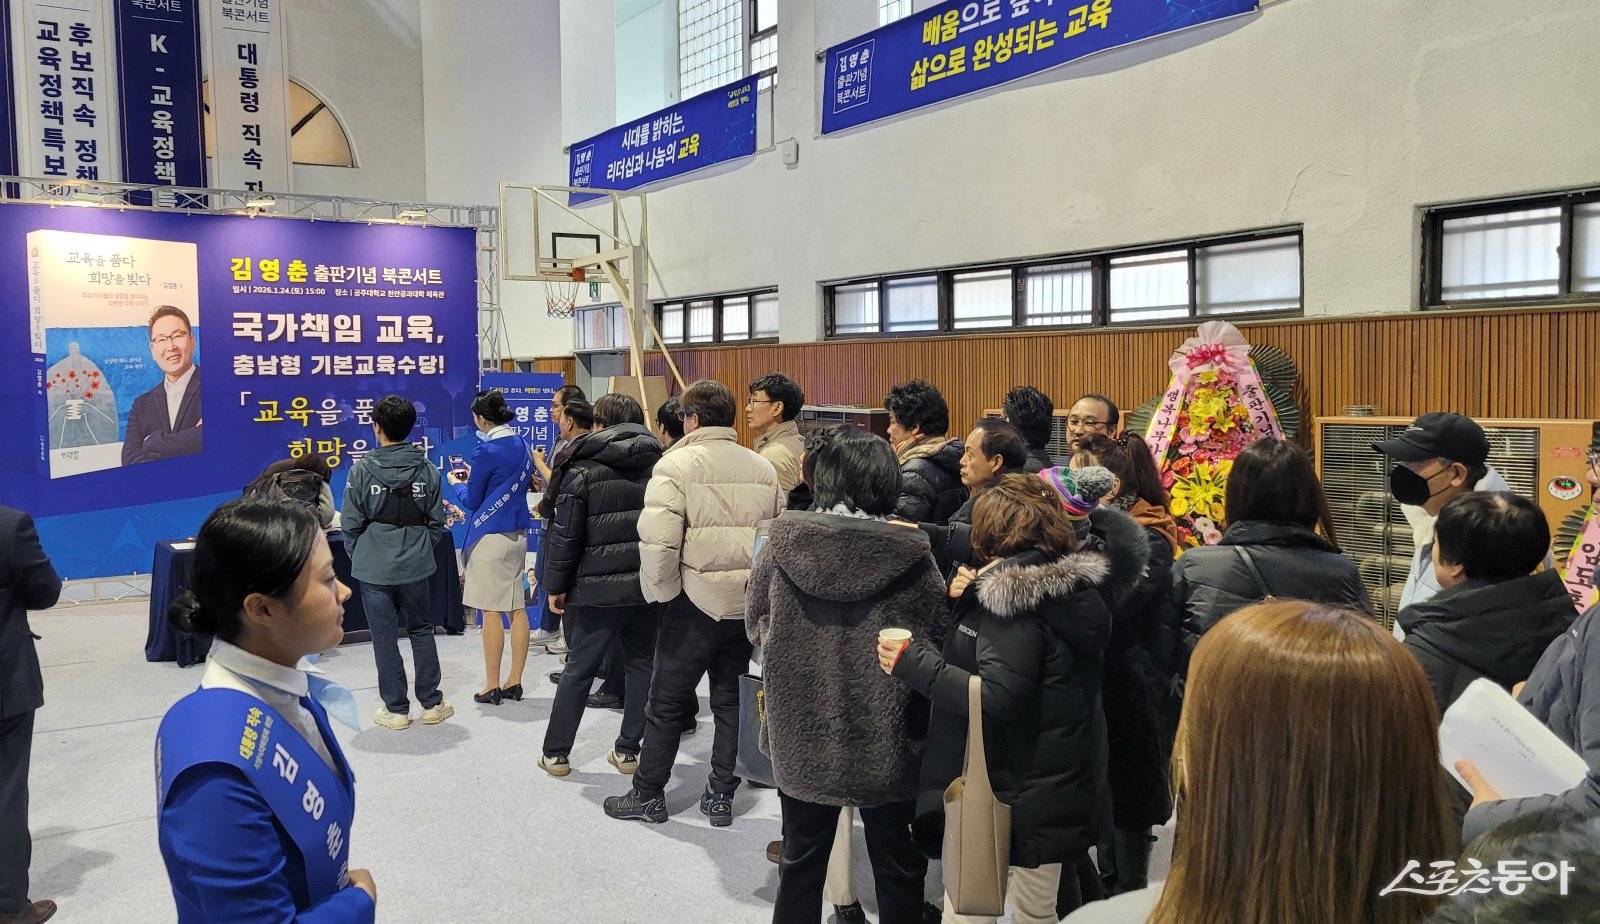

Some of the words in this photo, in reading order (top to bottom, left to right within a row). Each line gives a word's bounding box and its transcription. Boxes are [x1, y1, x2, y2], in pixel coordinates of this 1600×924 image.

[222, 7, 271, 23] 북콘서트
[910, 46, 966, 91] 삶으로
[972, 19, 1058, 73] 완성되는
[1063, 0, 1112, 39] 교육
[69, 22, 97, 128] 후보직속
[237, 43, 260, 113] 대통령
[837, 66, 868, 90] 출판기념
[36, 20, 68, 177] 교육정책특보
[837, 84, 867, 105] 북콘서트
[242, 124, 263, 170] 직속
[621, 122, 650, 151] 시대를
[652, 112, 686, 143] 밝히는,
[606, 152, 645, 183] 리더십과
[645, 142, 677, 171] 나눔의
[677, 133, 701, 160] 교육
[66, 252, 106, 267] 교육을
[109, 253, 136, 268] 품다
[313, 264, 377, 284] 출판기념
[381, 267, 443, 285] 북콘서트
[88, 271, 125, 286] 희망을
[127, 272, 151, 286] 빚다
[232, 285, 247, 294] 일시
[305, 287, 326, 295] 15:00
[334, 288, 349, 297] 장소
[354, 288, 387, 298] 공주대학교
[387, 289, 425, 298] 천안공과대학
[426, 289, 445, 299] 체육관
[232, 312, 361, 343] 국가책임
[376, 315, 444, 344] 교육,
[233, 354, 301, 376] 충남형
[311, 354, 445, 375] 기본교육수당!
[1242, 384, 1275, 437] 출판기념
[246, 707, 264, 727] 직속
[239, 725, 258, 760] 대통령
